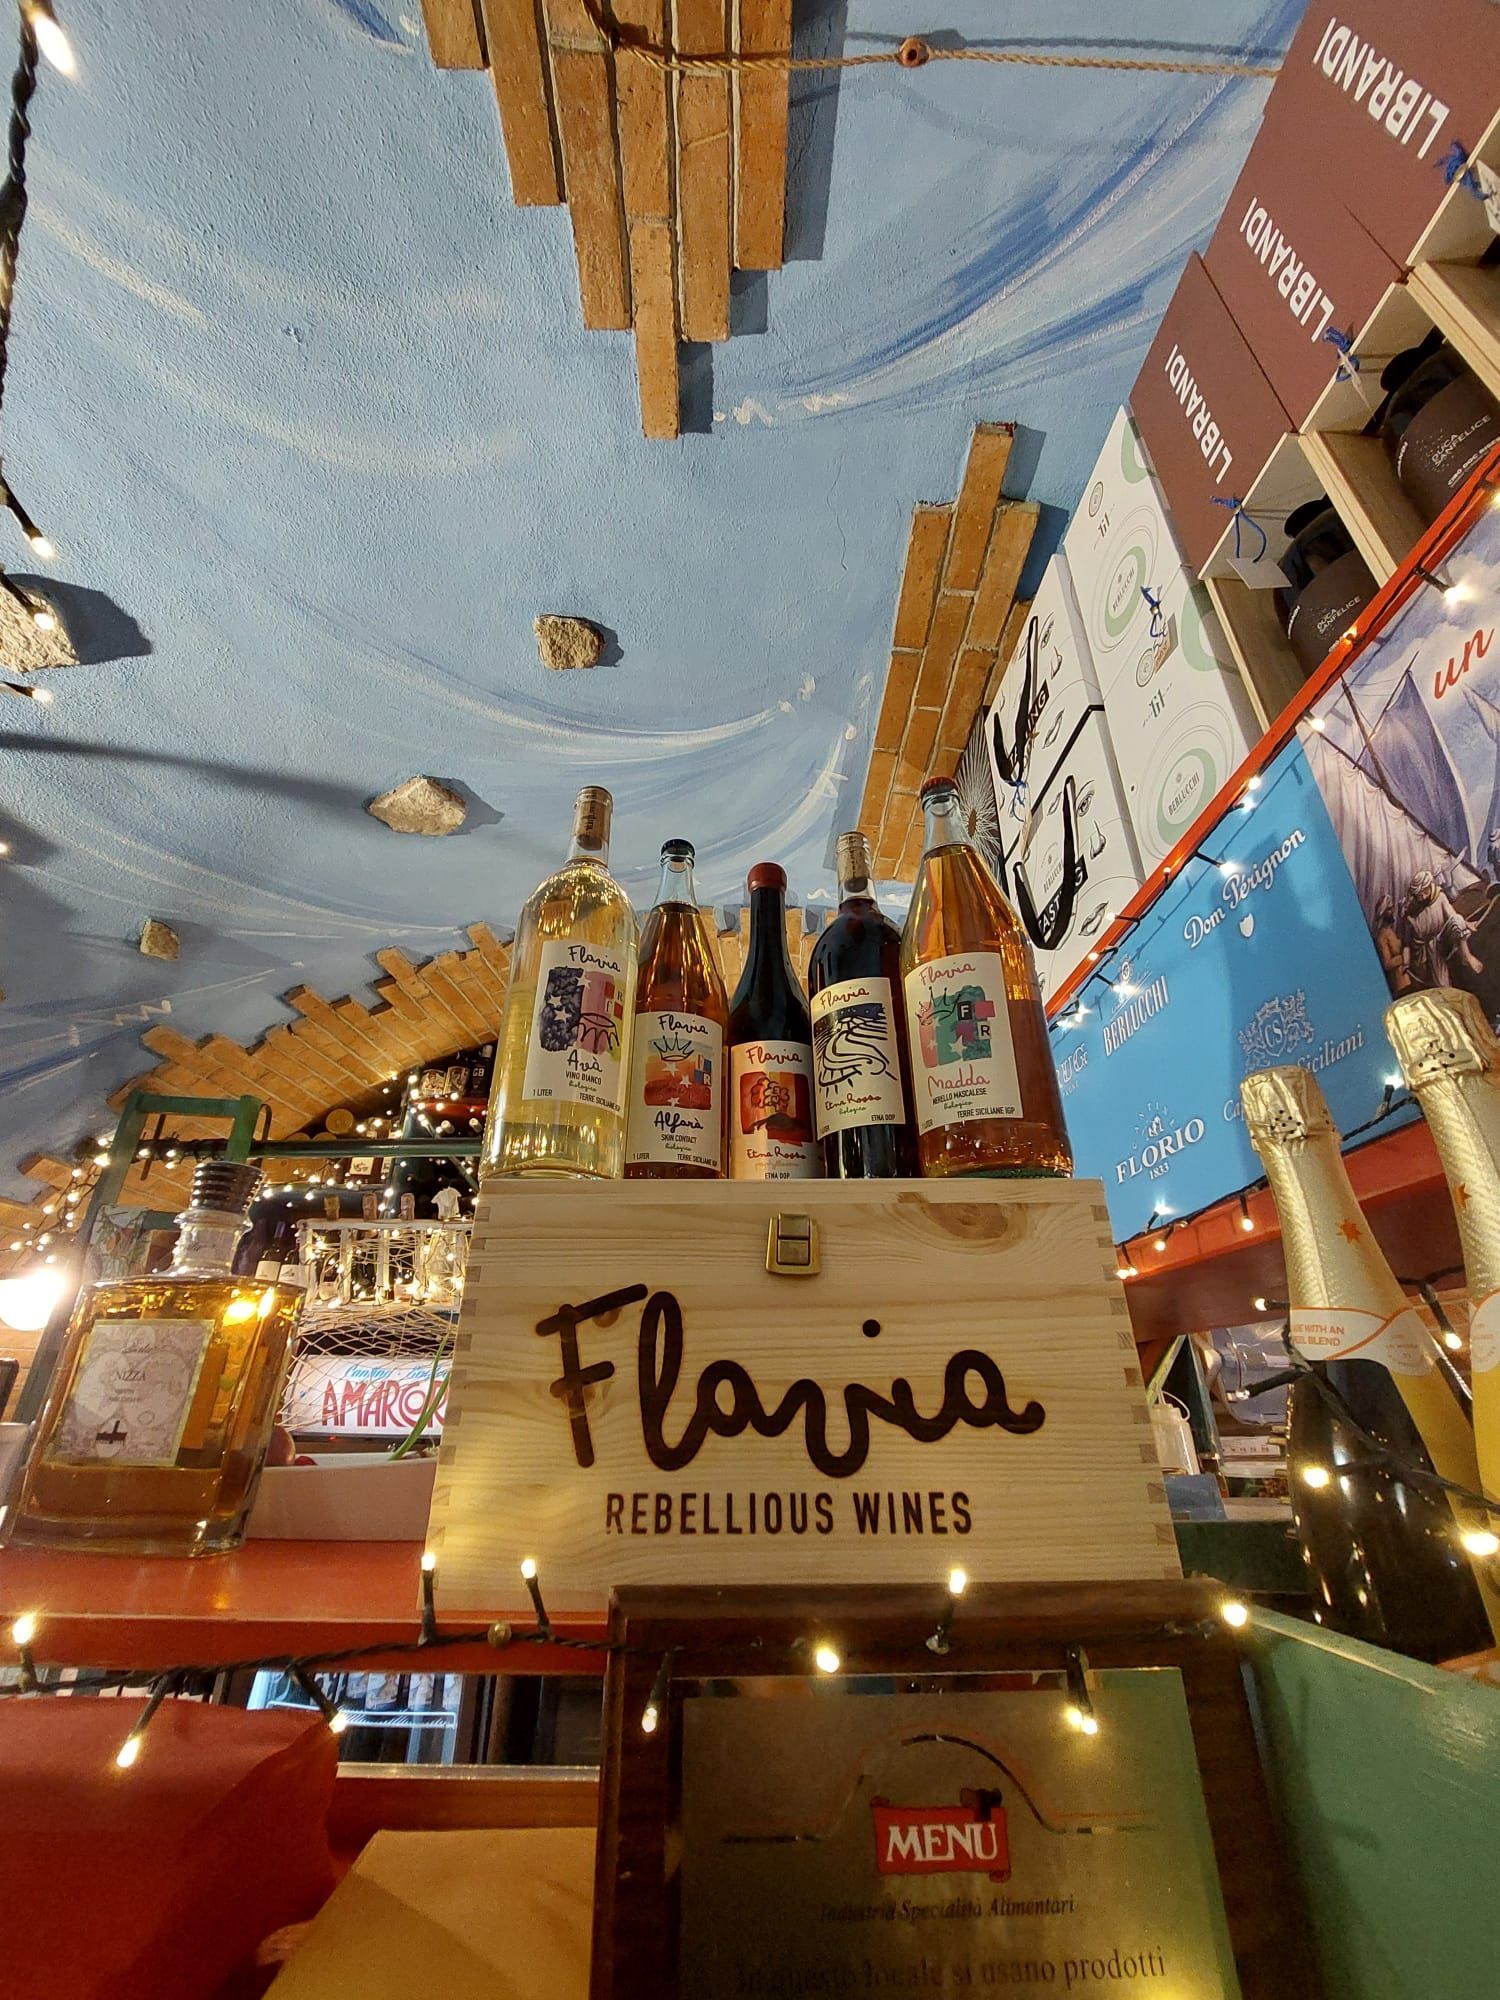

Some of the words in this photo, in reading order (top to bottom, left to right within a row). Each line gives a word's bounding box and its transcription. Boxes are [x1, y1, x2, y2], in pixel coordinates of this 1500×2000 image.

[1312, 16, 1450, 160] LIBRANDI
[1240, 197, 1335, 343] LIBRANDI
[1164, 343, 1233, 485] LIBRANDI
[1431, 434, 1458, 462] DUCA
[1435, 415, 1492, 467] SANFELICE
[1317, 607, 1337, 631] DUCA
[1319, 596, 1361, 634] SANFELICE
[1434, 628, 1495, 700] un
[1168, 771, 1200, 816] BERLUCCHI
[1183, 908, 1225, 948] Dom
[1222, 829, 1306, 910] Pérignon
[568, 944, 621, 973] Flavia
[918, 962, 976, 987] Flavia
[819, 986, 870, 1011] Flavia
[960, 1004, 969, 1018] F
[1103, 975, 1169, 1057] BERLUCCHI
[657, 1013, 709, 1035] Flavia
[980, 1024, 991, 1036] R
[567, 1049, 603, 1073] Avà
[745, 1046, 803, 1065] Flavia
[565, 1071, 581, 1080] VINO
[581, 1072, 602, 1085] BIANCO
[927, 1063, 990, 1097] Madda
[580, 1092, 596, 1103] TERRE
[825, 1100, 847, 1111] Etna
[847, 1092, 882, 1104] Rosso
[933, 1092, 953, 1105] NERELLO
[953, 1087, 987, 1100] MASCALESE
[654, 1111, 704, 1133] Alfarà
[957, 1109, 975, 1118] TERRE
[975, 1107, 1004, 1116] SICILIANE
[661, 1134, 674, 1142] SKIN
[675, 1135, 697, 1144] CONTACT
[1115, 1118, 1205, 1184] FLORIO
[677, 1154, 692, 1162] TERRE
[746, 1149, 771, 1159] Etna
[764, 1172, 778, 1180] ETNA
[1150, 1162, 1169, 1180] 1833
[1308, 1336, 1341, 1346] BLEND
[1330, 1325, 1345, 1335] AN
[114, 1370, 147, 1382] NIZZA
[535, 1283, 1046, 1479] Flavia
[322, 1379, 449, 1428] AMARCOR
[605, 1492, 834, 1535] REBELLIOUS
[853, 1491, 973, 1535] WINES
[886, 1823, 998, 1863] MENU
[988, 1894, 1075, 1917] Alimentari
[981, 1959, 1056, 1986] usano
[1063, 1946, 1166, 1990] prodotti
